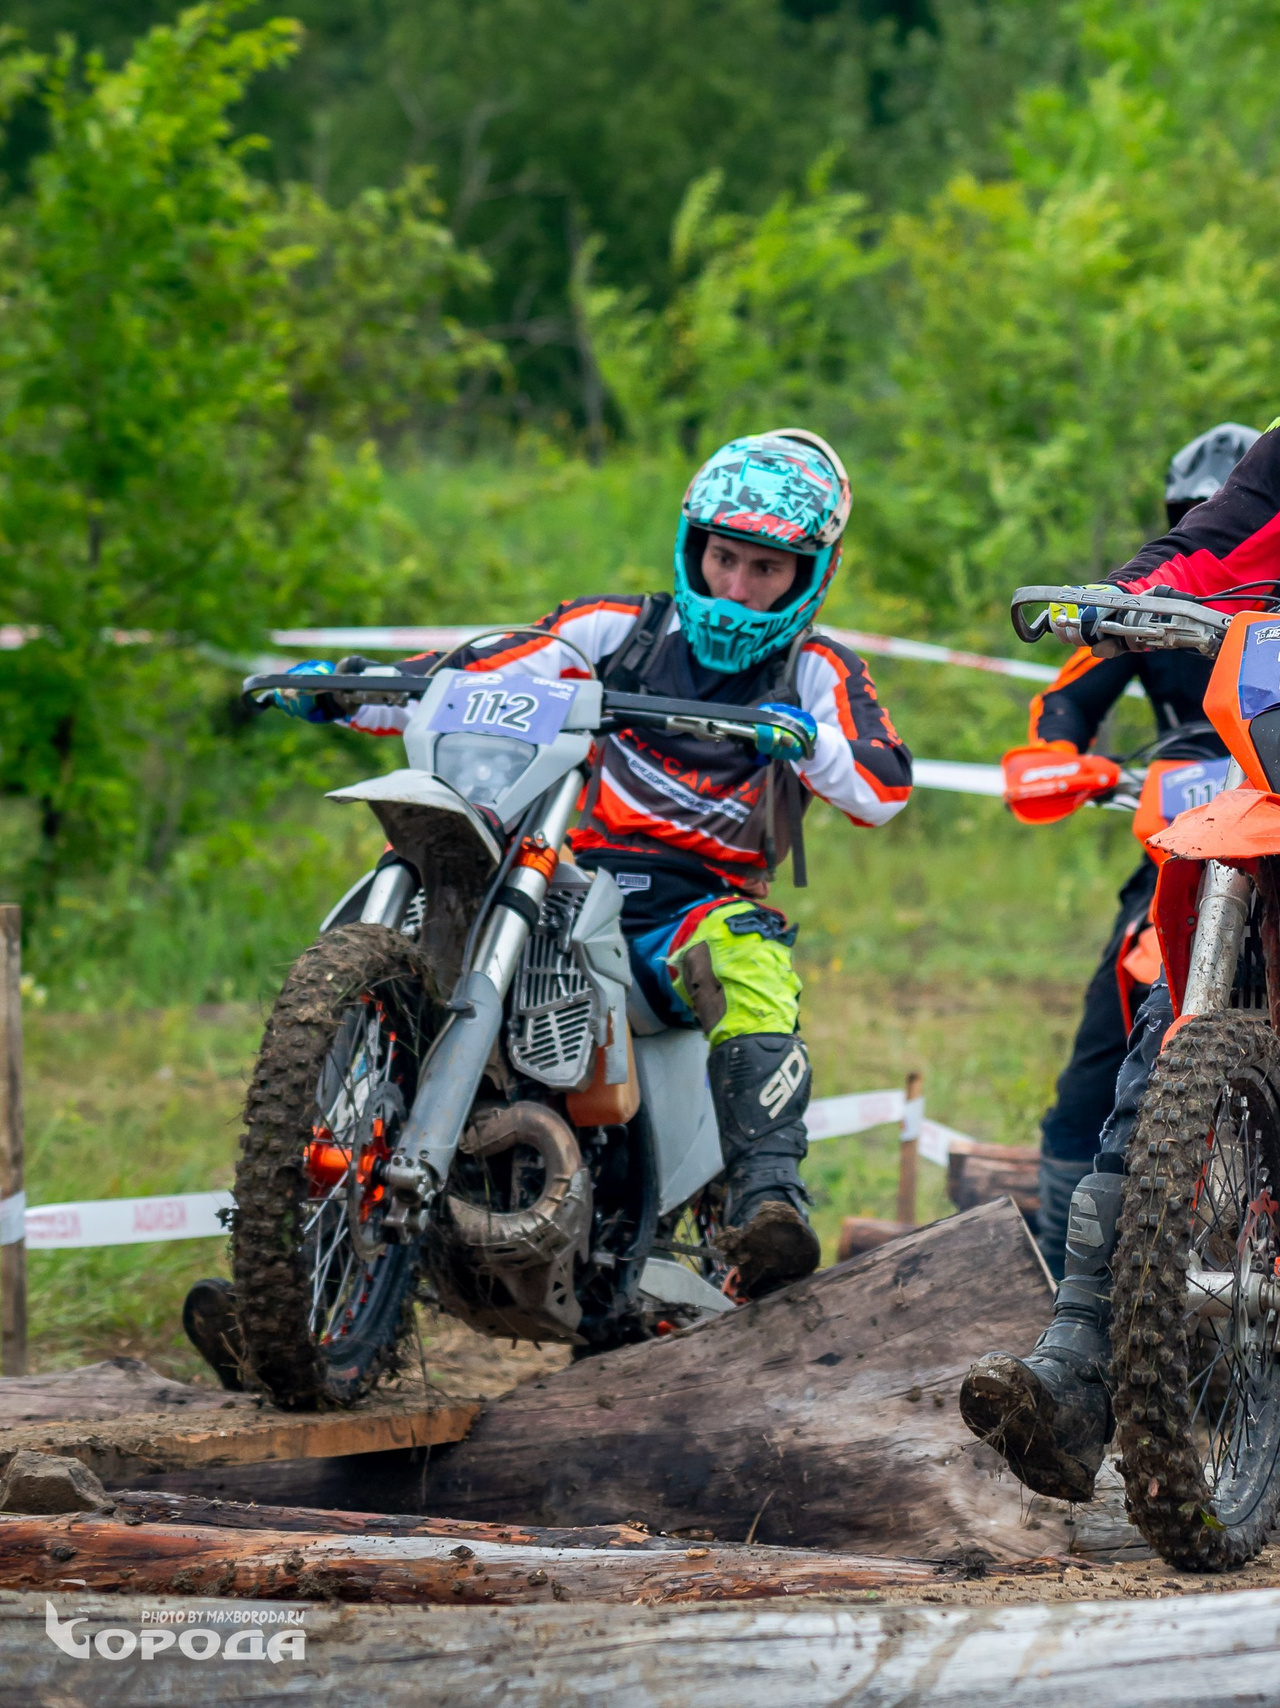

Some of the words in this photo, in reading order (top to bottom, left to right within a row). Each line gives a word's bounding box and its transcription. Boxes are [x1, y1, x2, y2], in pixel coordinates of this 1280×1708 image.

[1057, 590, 1142, 607] ZETA
[462, 689, 539, 733] 112
[1181, 777, 1227, 809] 11
